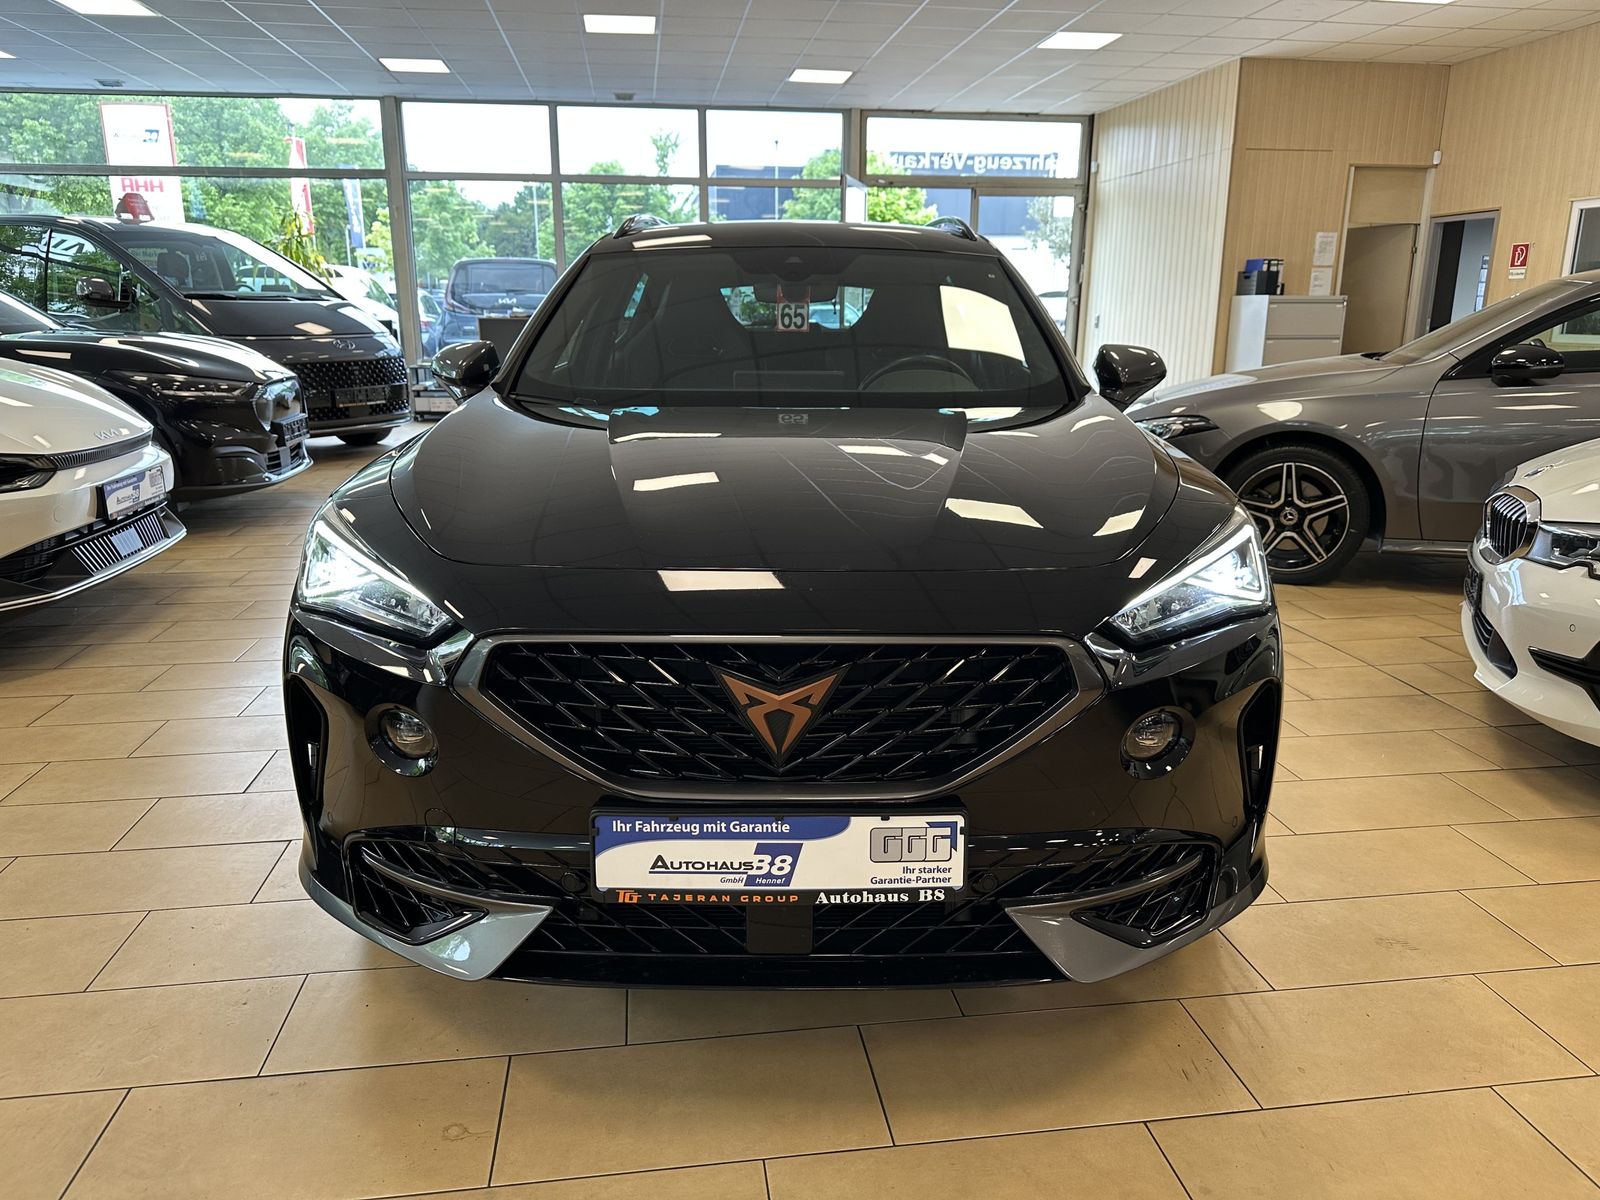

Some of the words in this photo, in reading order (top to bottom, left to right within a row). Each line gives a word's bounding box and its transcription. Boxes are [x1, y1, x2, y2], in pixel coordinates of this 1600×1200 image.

[781, 303, 805, 329] 65
[612, 820, 632, 832] Ihr
[635, 820, 700, 835] Fahrzeug
[703, 821, 726, 833] mit
[729, 821, 790, 833] Garantie
[869, 827, 952, 864] GGG
[902, 866, 916, 875] Ihr
[918, 865, 952, 875] starker
[719, 876, 744, 885] GmbH
[870, 875, 952, 885] Garantie-Partner
[648, 893, 731, 902] TAJERAN
[740, 895, 799, 903] GROUP
[815, 890, 909, 904] Autohaus
[918, 889, 945, 902] B8
